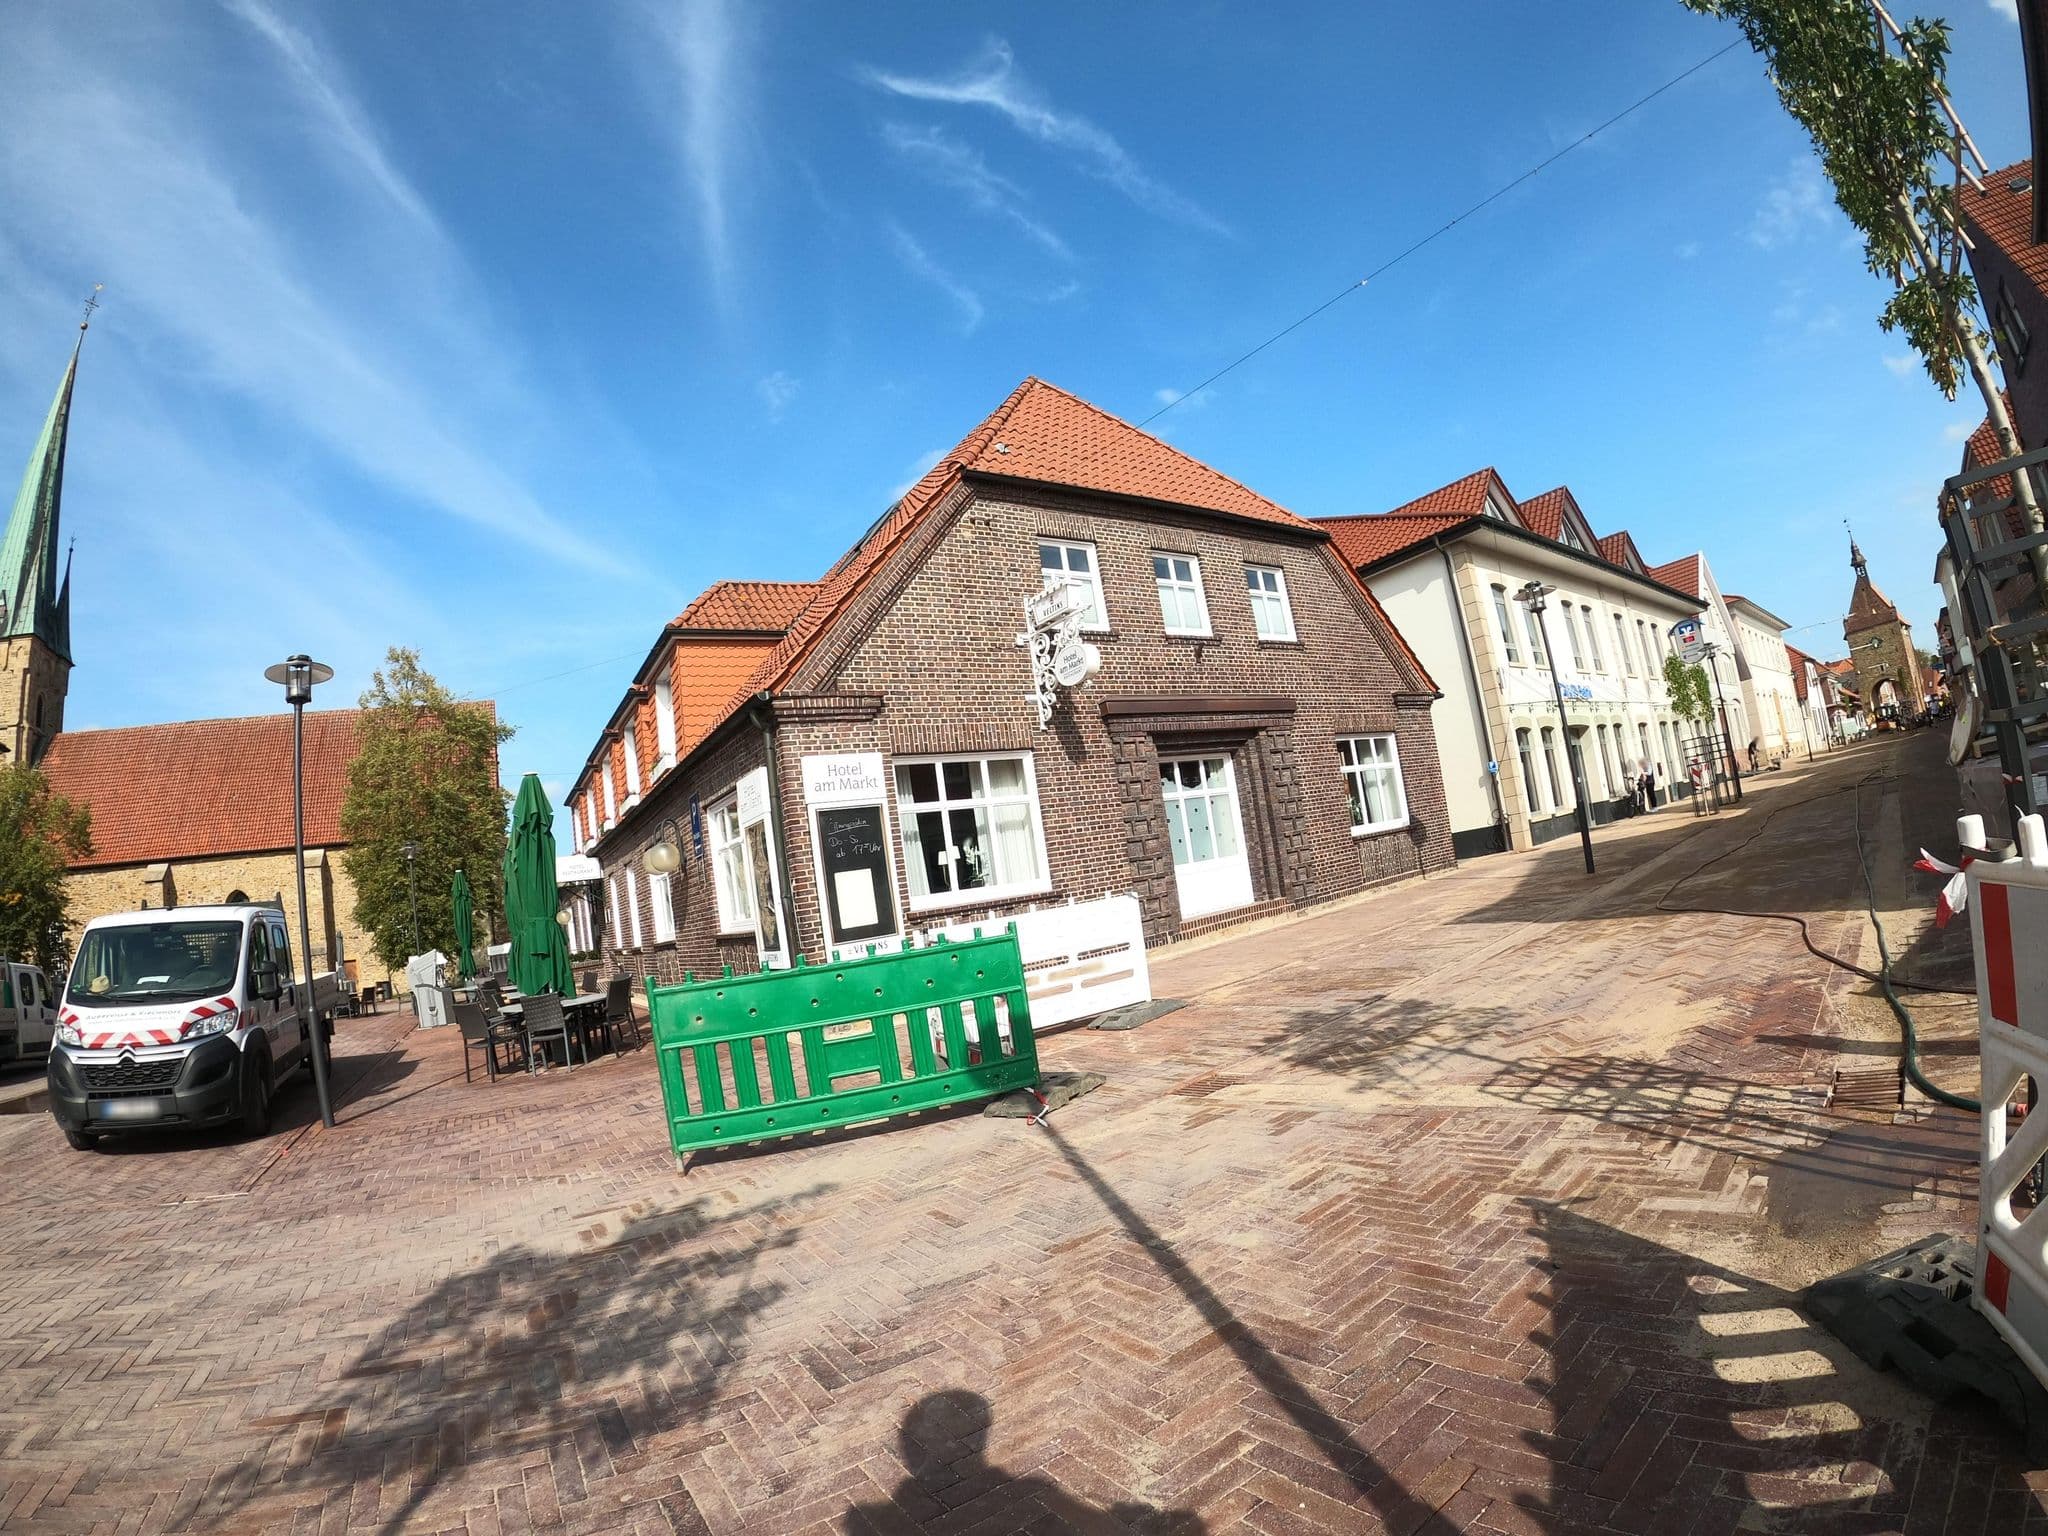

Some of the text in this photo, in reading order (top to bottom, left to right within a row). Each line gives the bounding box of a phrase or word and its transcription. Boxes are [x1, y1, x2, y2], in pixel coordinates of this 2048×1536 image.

[828, 762, 862, 777] Hotel
[814, 775, 879, 792] am Markt
